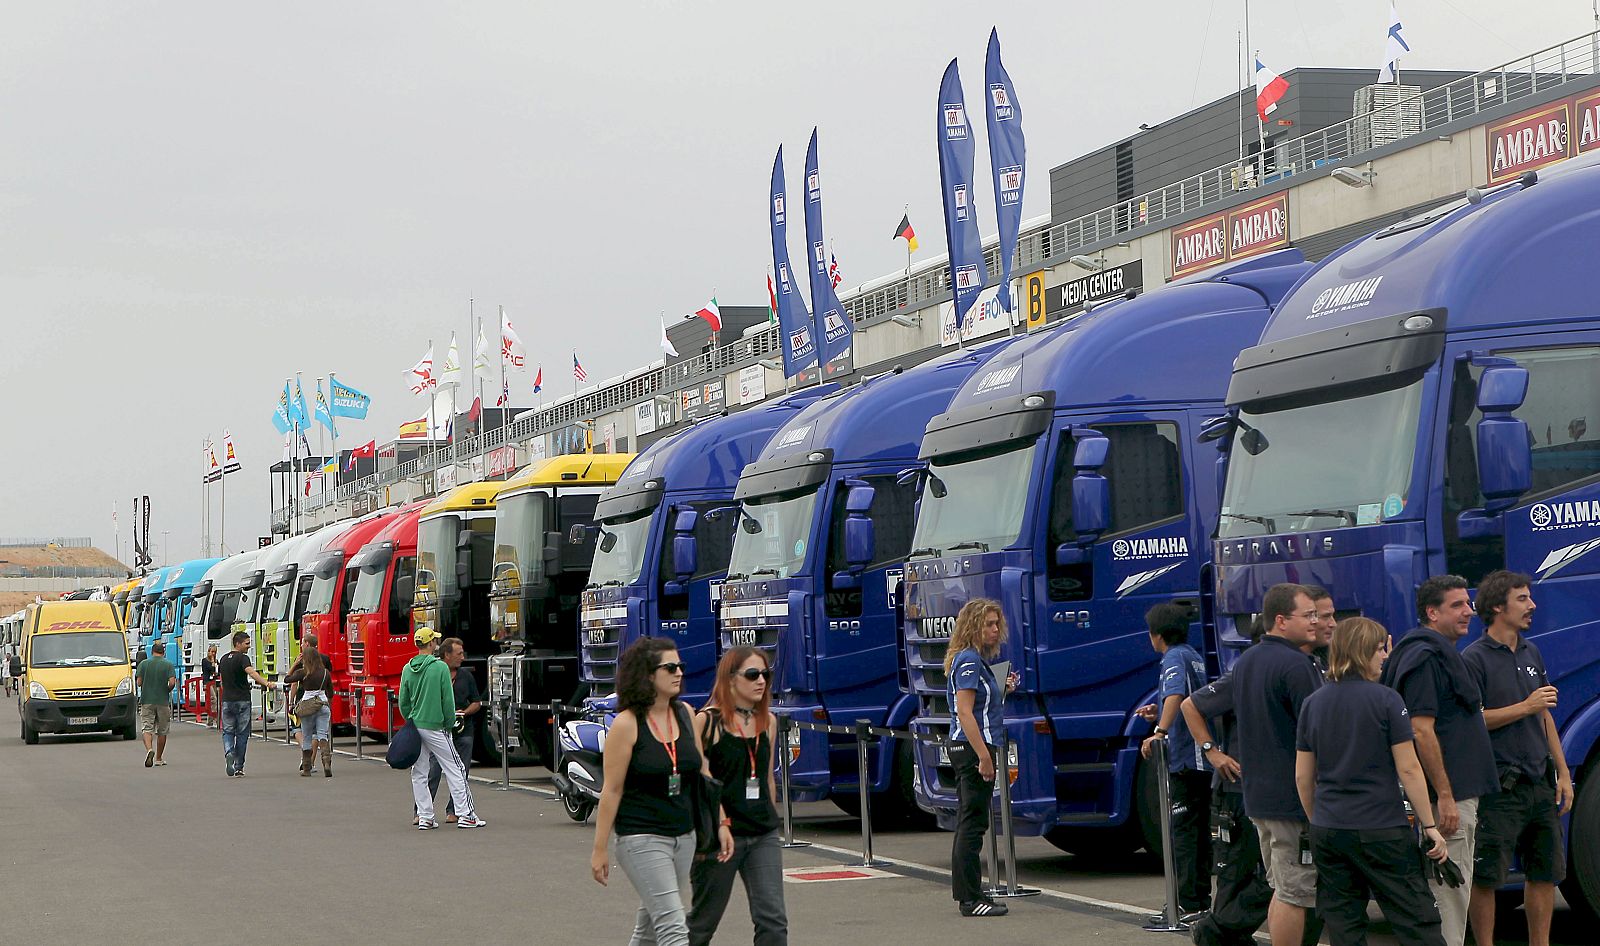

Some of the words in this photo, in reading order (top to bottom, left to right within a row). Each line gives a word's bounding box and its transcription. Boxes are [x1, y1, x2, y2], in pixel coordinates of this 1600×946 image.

[1492, 119, 1564, 172] AMBAR
[1231, 207, 1282, 251] AMBAR
[1175, 228, 1222, 268] AMBAR
[1061, 279, 1089, 307] MEDIA
[1089, 268, 1124, 298] CENTER
[1324, 275, 1384, 310] YAMAHA
[1029, 276, 1042, 322] B
[1305, 307, 1340, 321] FACTORY
[1340, 300, 1371, 312] RACING
[333, 397, 365, 409] SUZUKI
[1531, 523, 1583, 532] FACTORY
[1128, 536, 1189, 556] YAMAHA
[1222, 536, 1333, 557] STRALIS
[48, 620, 106, 631] DHL
[661, 621, 688, 631] 500
[829, 620, 861, 631] 500
[1052, 610, 1090, 622] 450
[732, 629, 756, 646] IVECO
[922, 616, 957, 638] IVECO
